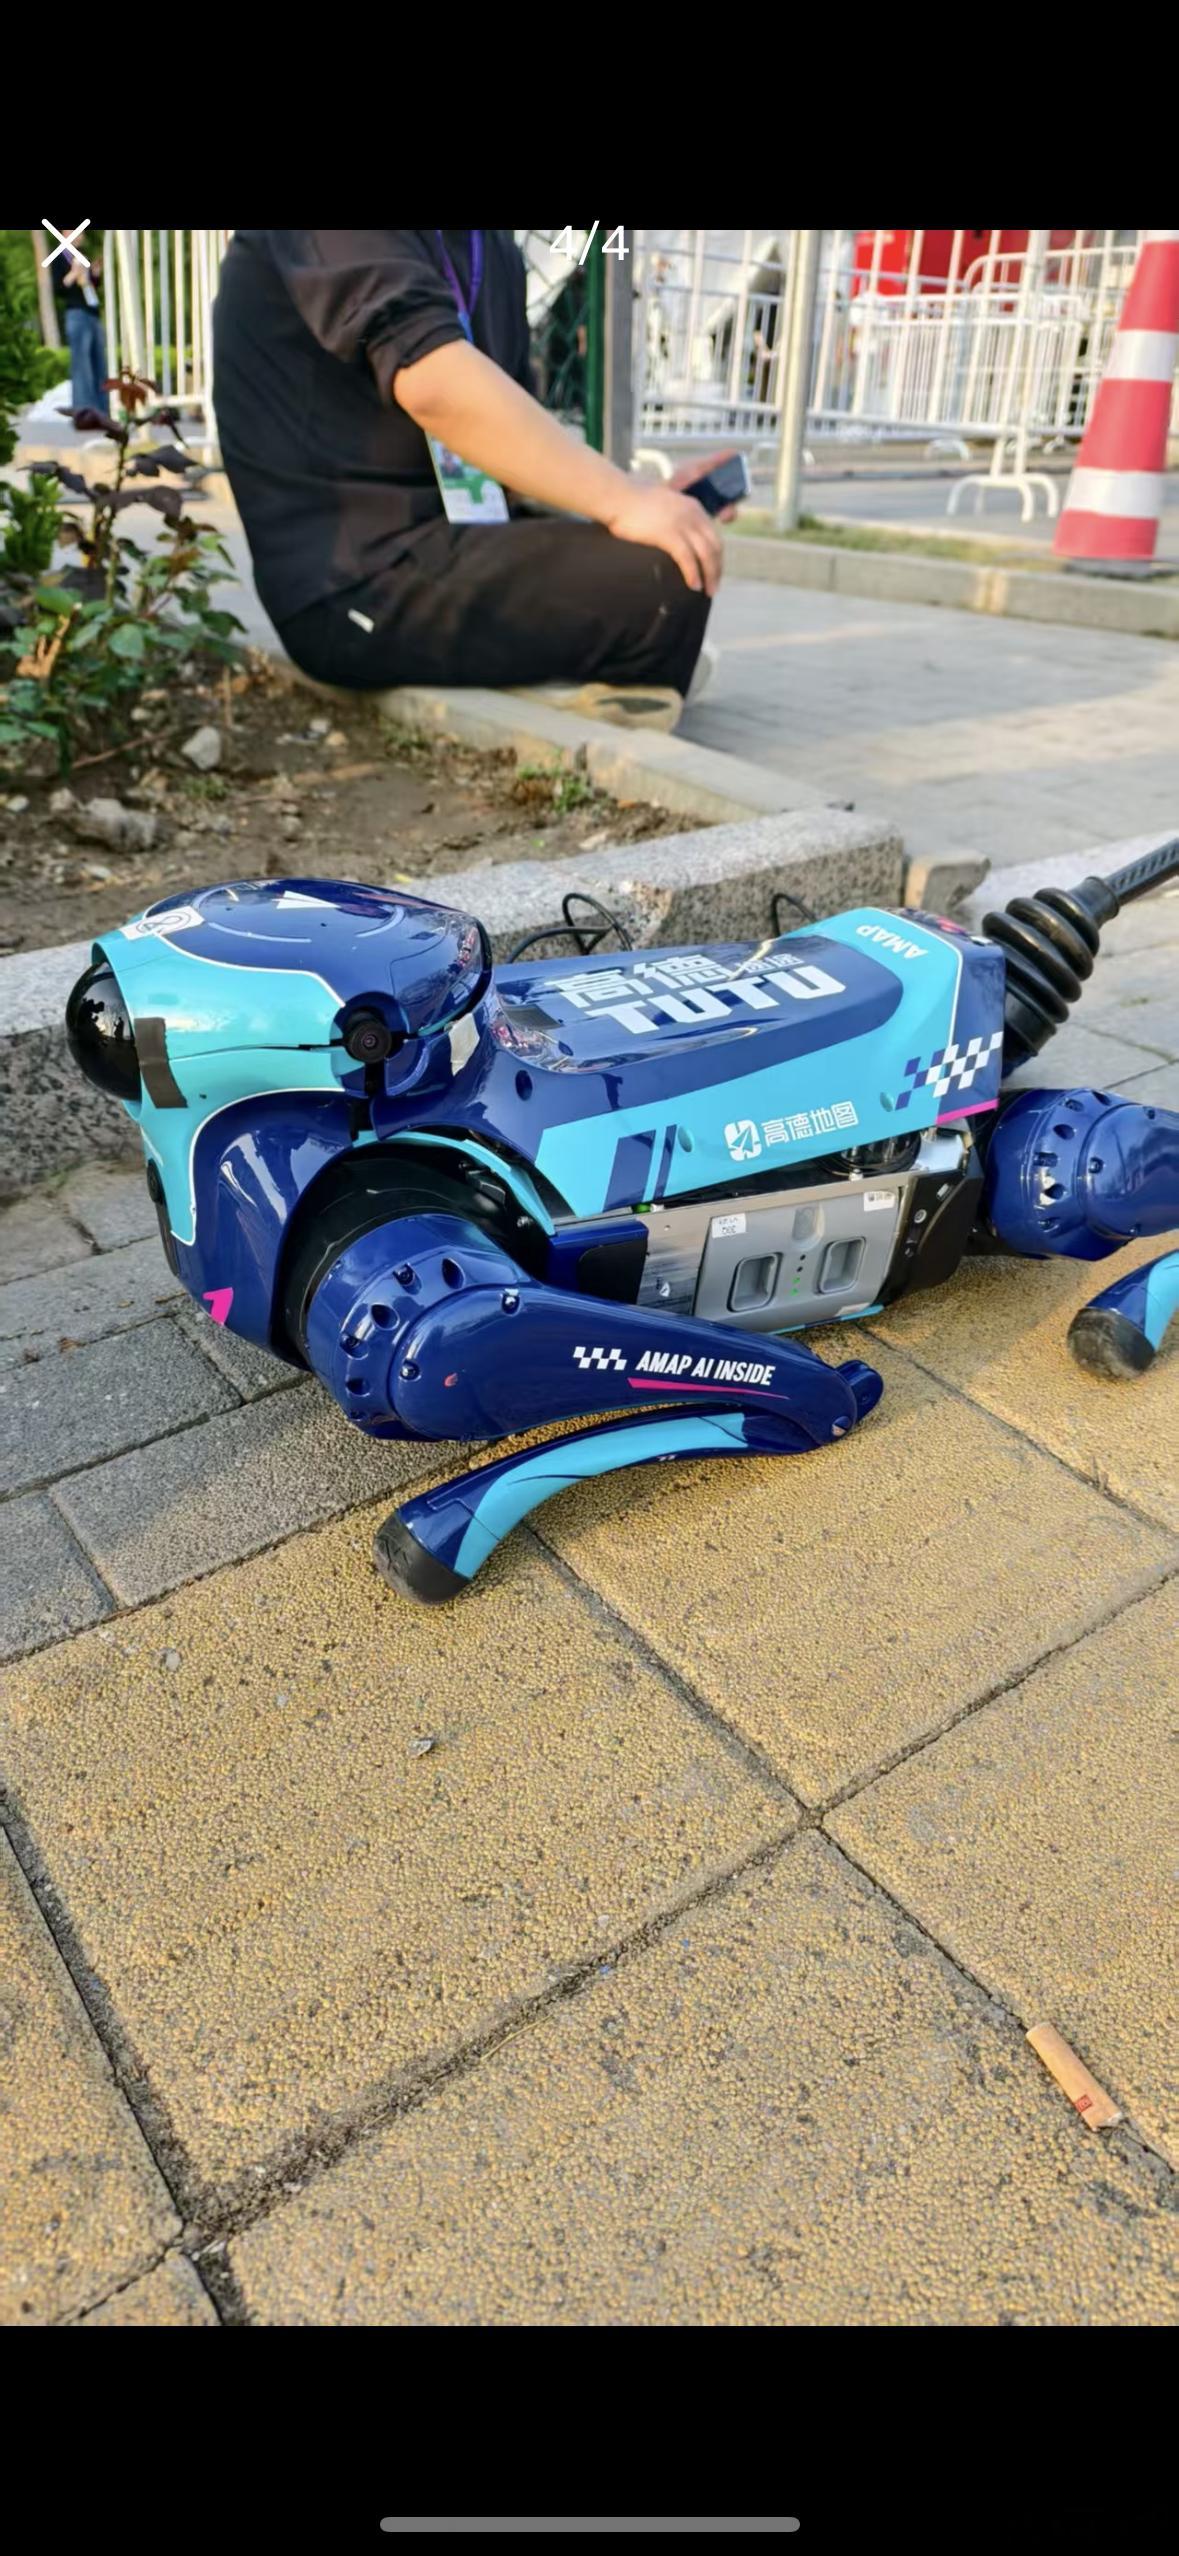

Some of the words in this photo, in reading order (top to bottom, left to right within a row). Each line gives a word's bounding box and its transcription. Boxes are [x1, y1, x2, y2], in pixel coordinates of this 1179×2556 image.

[856, 925, 929, 958] AMAP
[544, 954, 736, 1008] 高德
[585, 965, 846, 1034] TUTU
[761, 1101, 859, 1147] 高德地图
[635, 1350, 692, 1375] AMAP
[691, 1357, 714, 1378] AI
[714, 1360, 776, 1386] INSIDE
